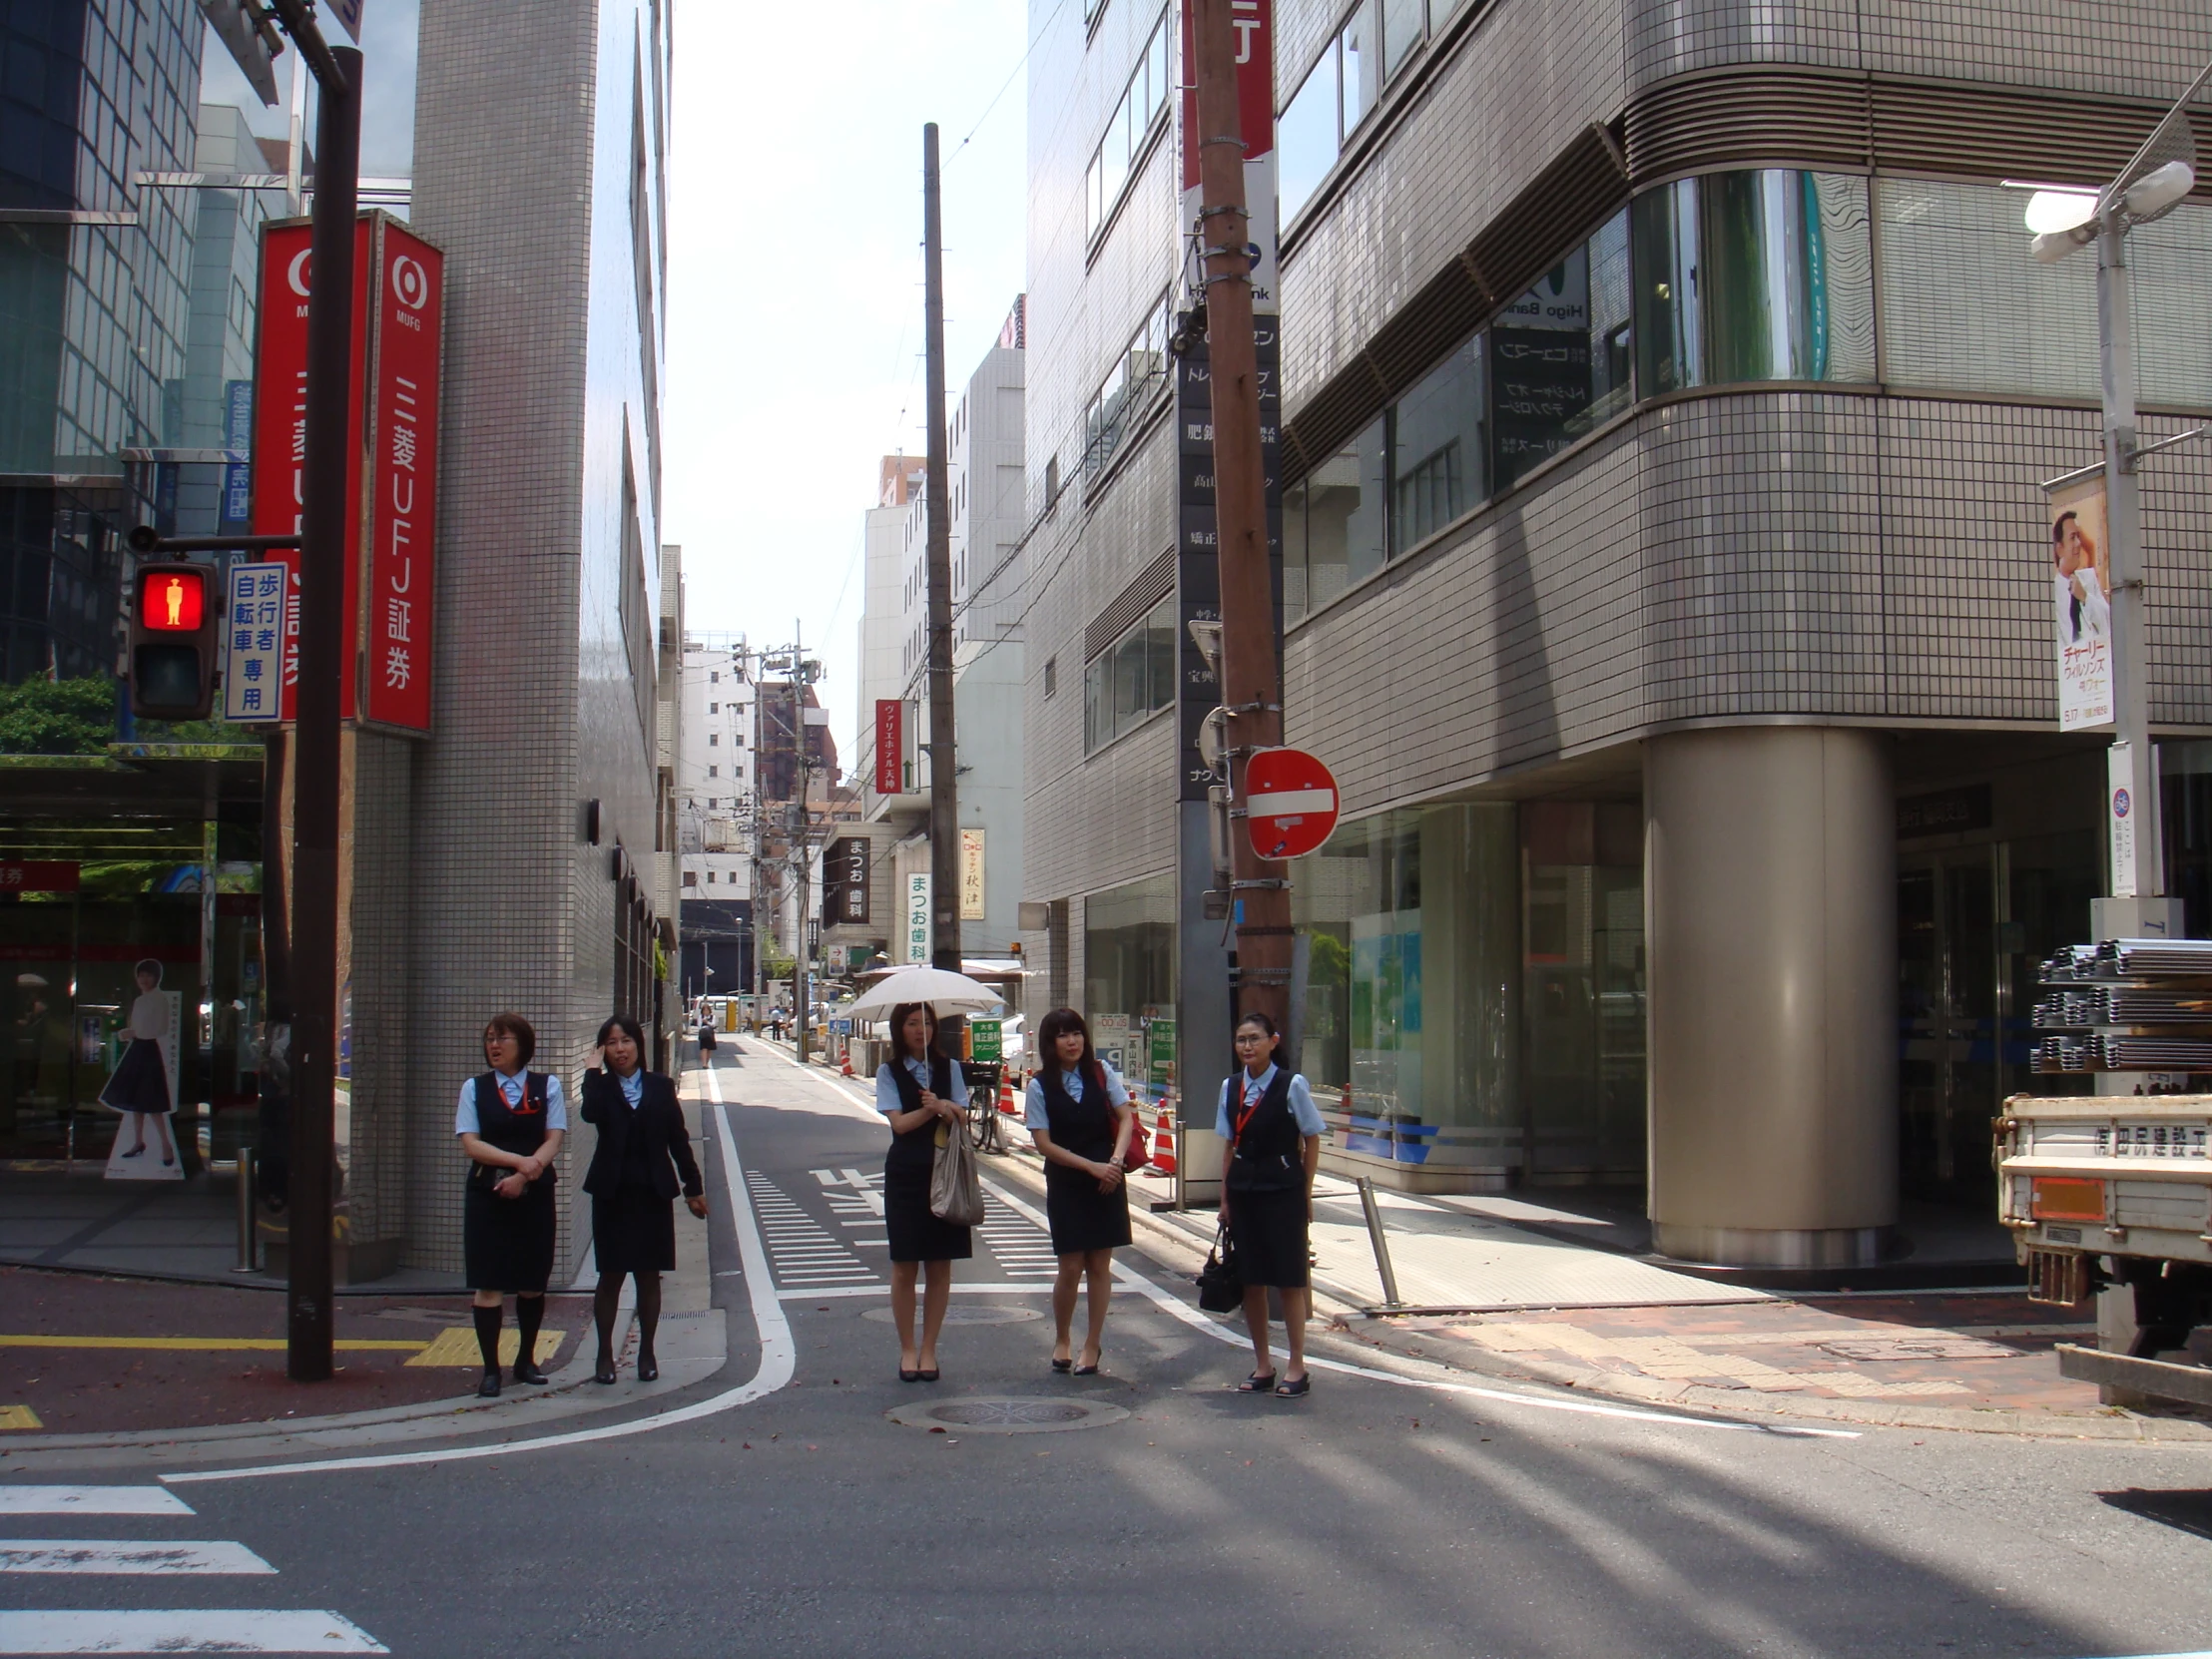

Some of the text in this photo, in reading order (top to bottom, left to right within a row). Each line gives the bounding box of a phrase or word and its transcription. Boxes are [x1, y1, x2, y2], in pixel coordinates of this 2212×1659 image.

[396, 309, 420, 331] MUFG
[386, 376, 417, 690] 三菱UFJ証券
[234, 576, 255, 652] 自転車
[256, 574, 278, 651] 歩行者
[243, 659, 263, 711] 専用
[2064, 641, 2105, 665] チャーリー
[2064, 658, 2105, 681] ウィルソンズ
[884, 705, 895, 790] ヴァリエホテル天神
[848, 840, 863, 917] まつお 歯科
[910, 876, 926, 960] まつお歯科
